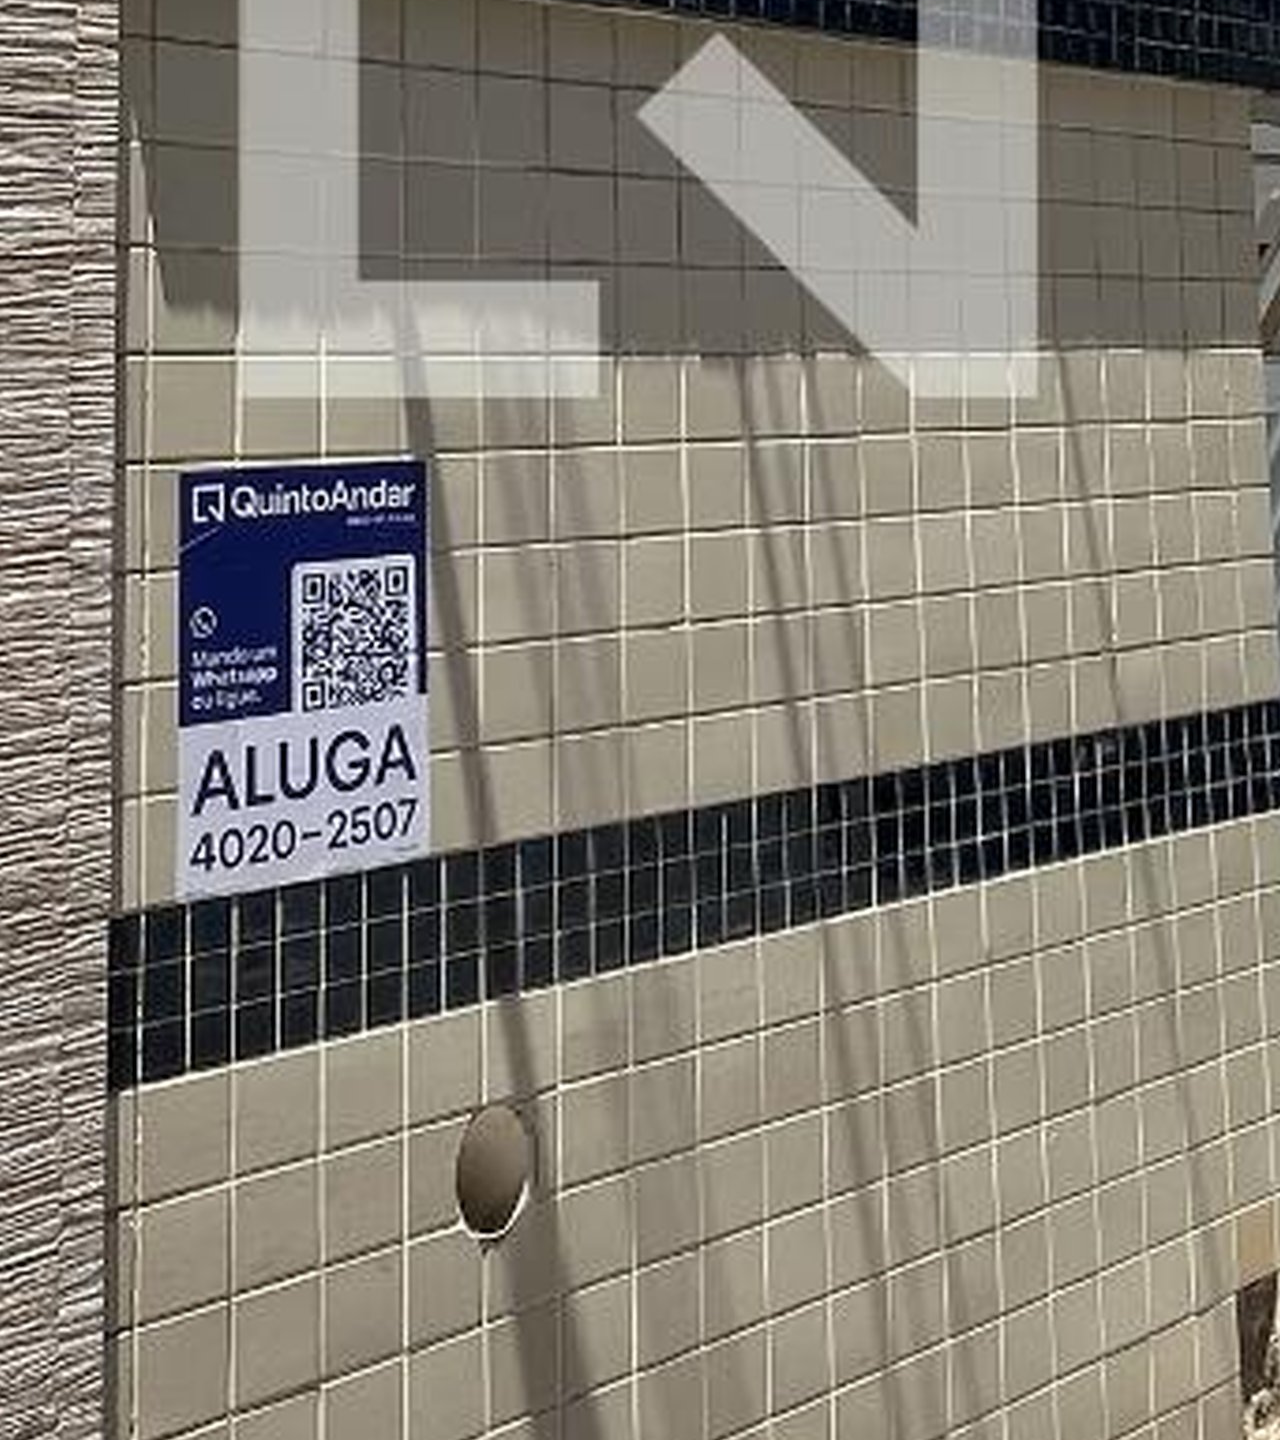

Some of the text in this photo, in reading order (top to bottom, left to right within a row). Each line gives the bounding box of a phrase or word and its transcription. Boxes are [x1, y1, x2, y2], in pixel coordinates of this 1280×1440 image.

[230, 480, 416, 519] QuintoAndar
[191, 724, 417, 815] ALUGA
[190, 798, 418, 872] 4020-2507
